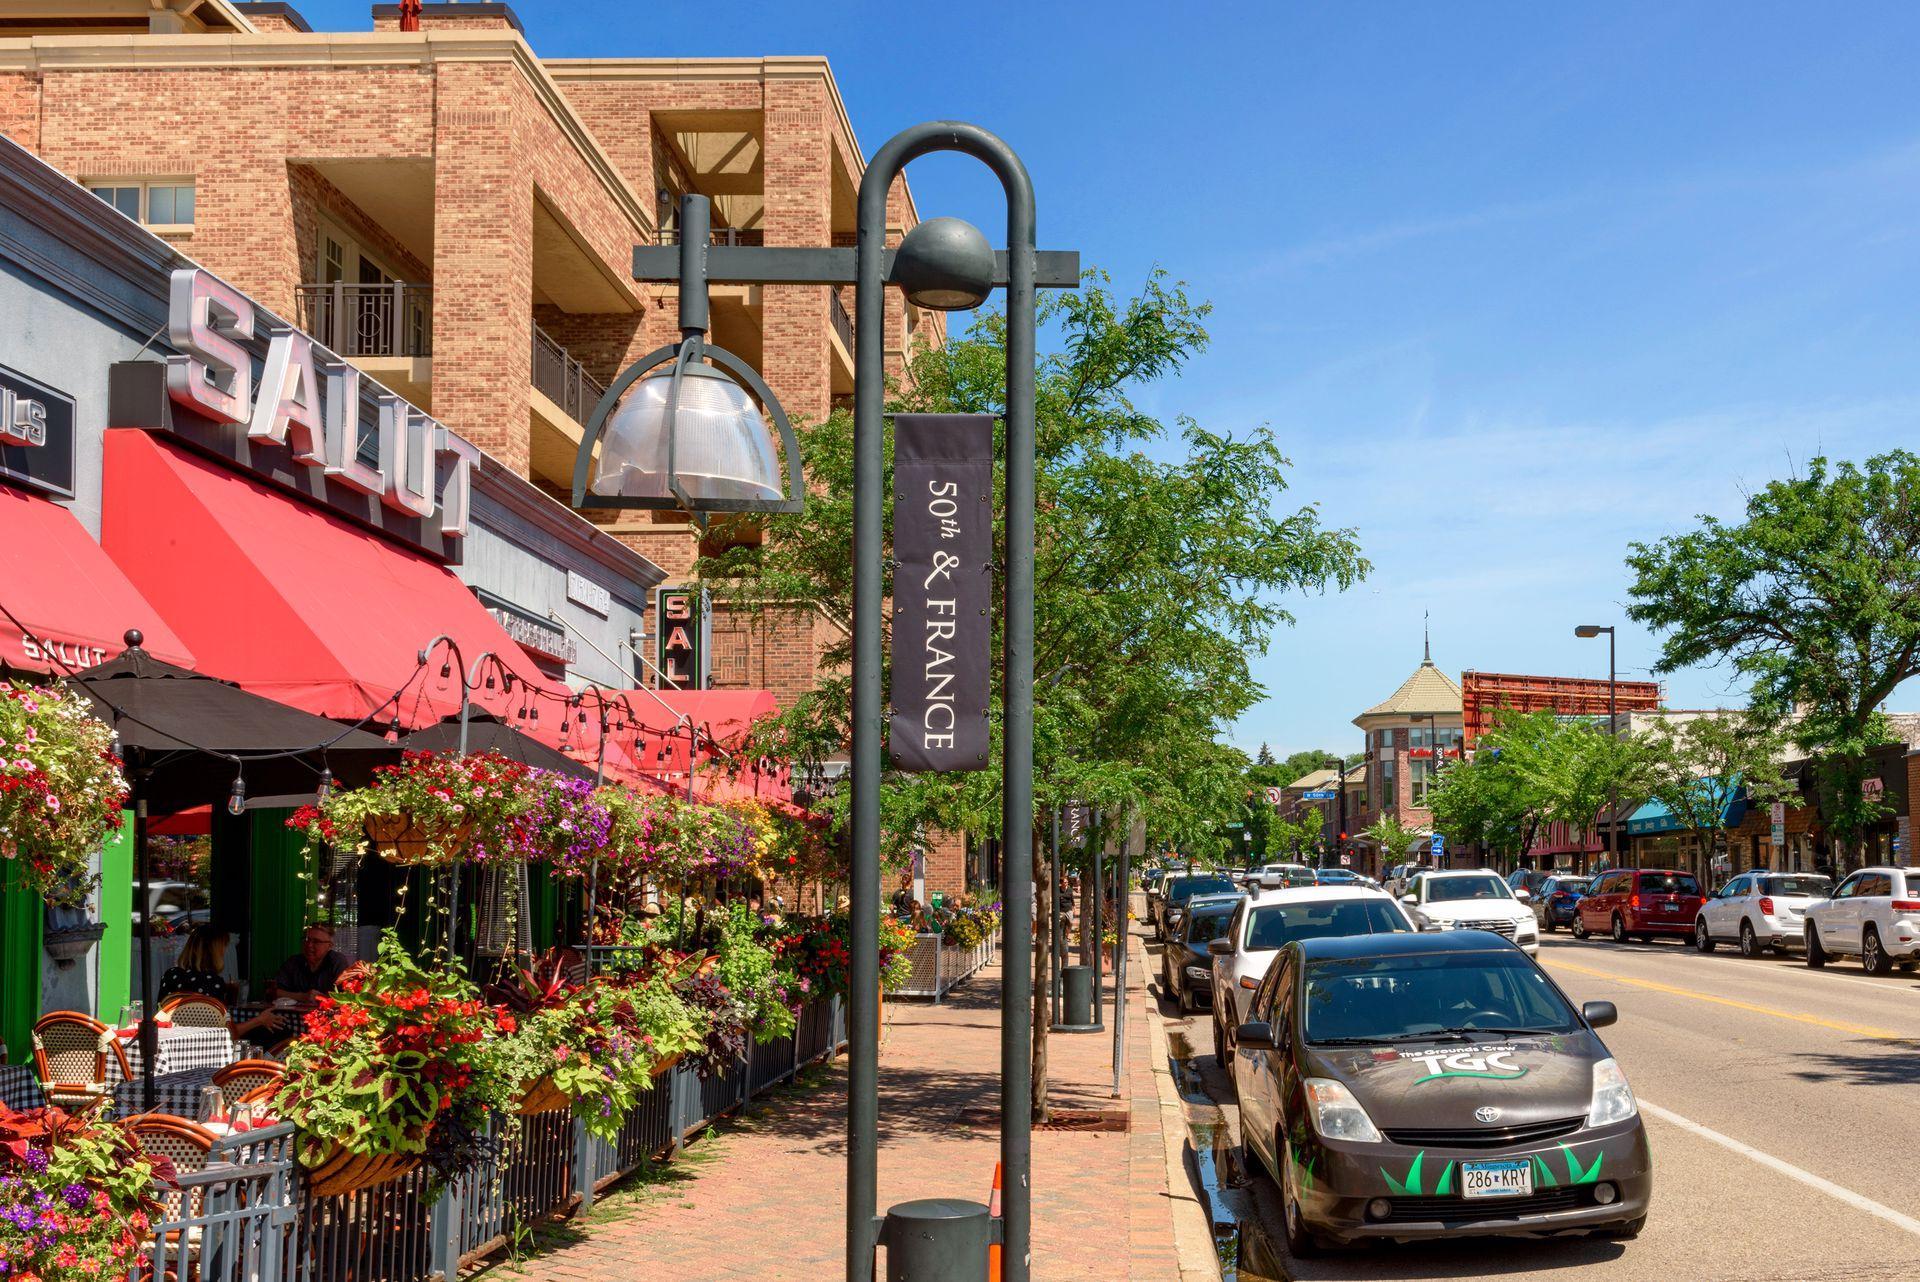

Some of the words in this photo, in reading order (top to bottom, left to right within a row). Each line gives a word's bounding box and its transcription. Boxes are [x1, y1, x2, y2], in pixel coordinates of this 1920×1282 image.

[167, 269, 481, 538] SALUT
[928, 480, 961, 539] 50th
[924, 550, 960, 590] &
[22, 633, 106, 669] SALUT
[924, 598, 956, 750] FRANCE
[1399, 1050, 1423, 1059] The
[1424, 1046, 1480, 1056] Grounds
[1482, 1044, 1516, 1052] Crew
[1411, 1051, 1521, 1075] TGC
[1467, 1170, 1492, 1188] 286
[1501, 1168, 1526, 1186] KRY
